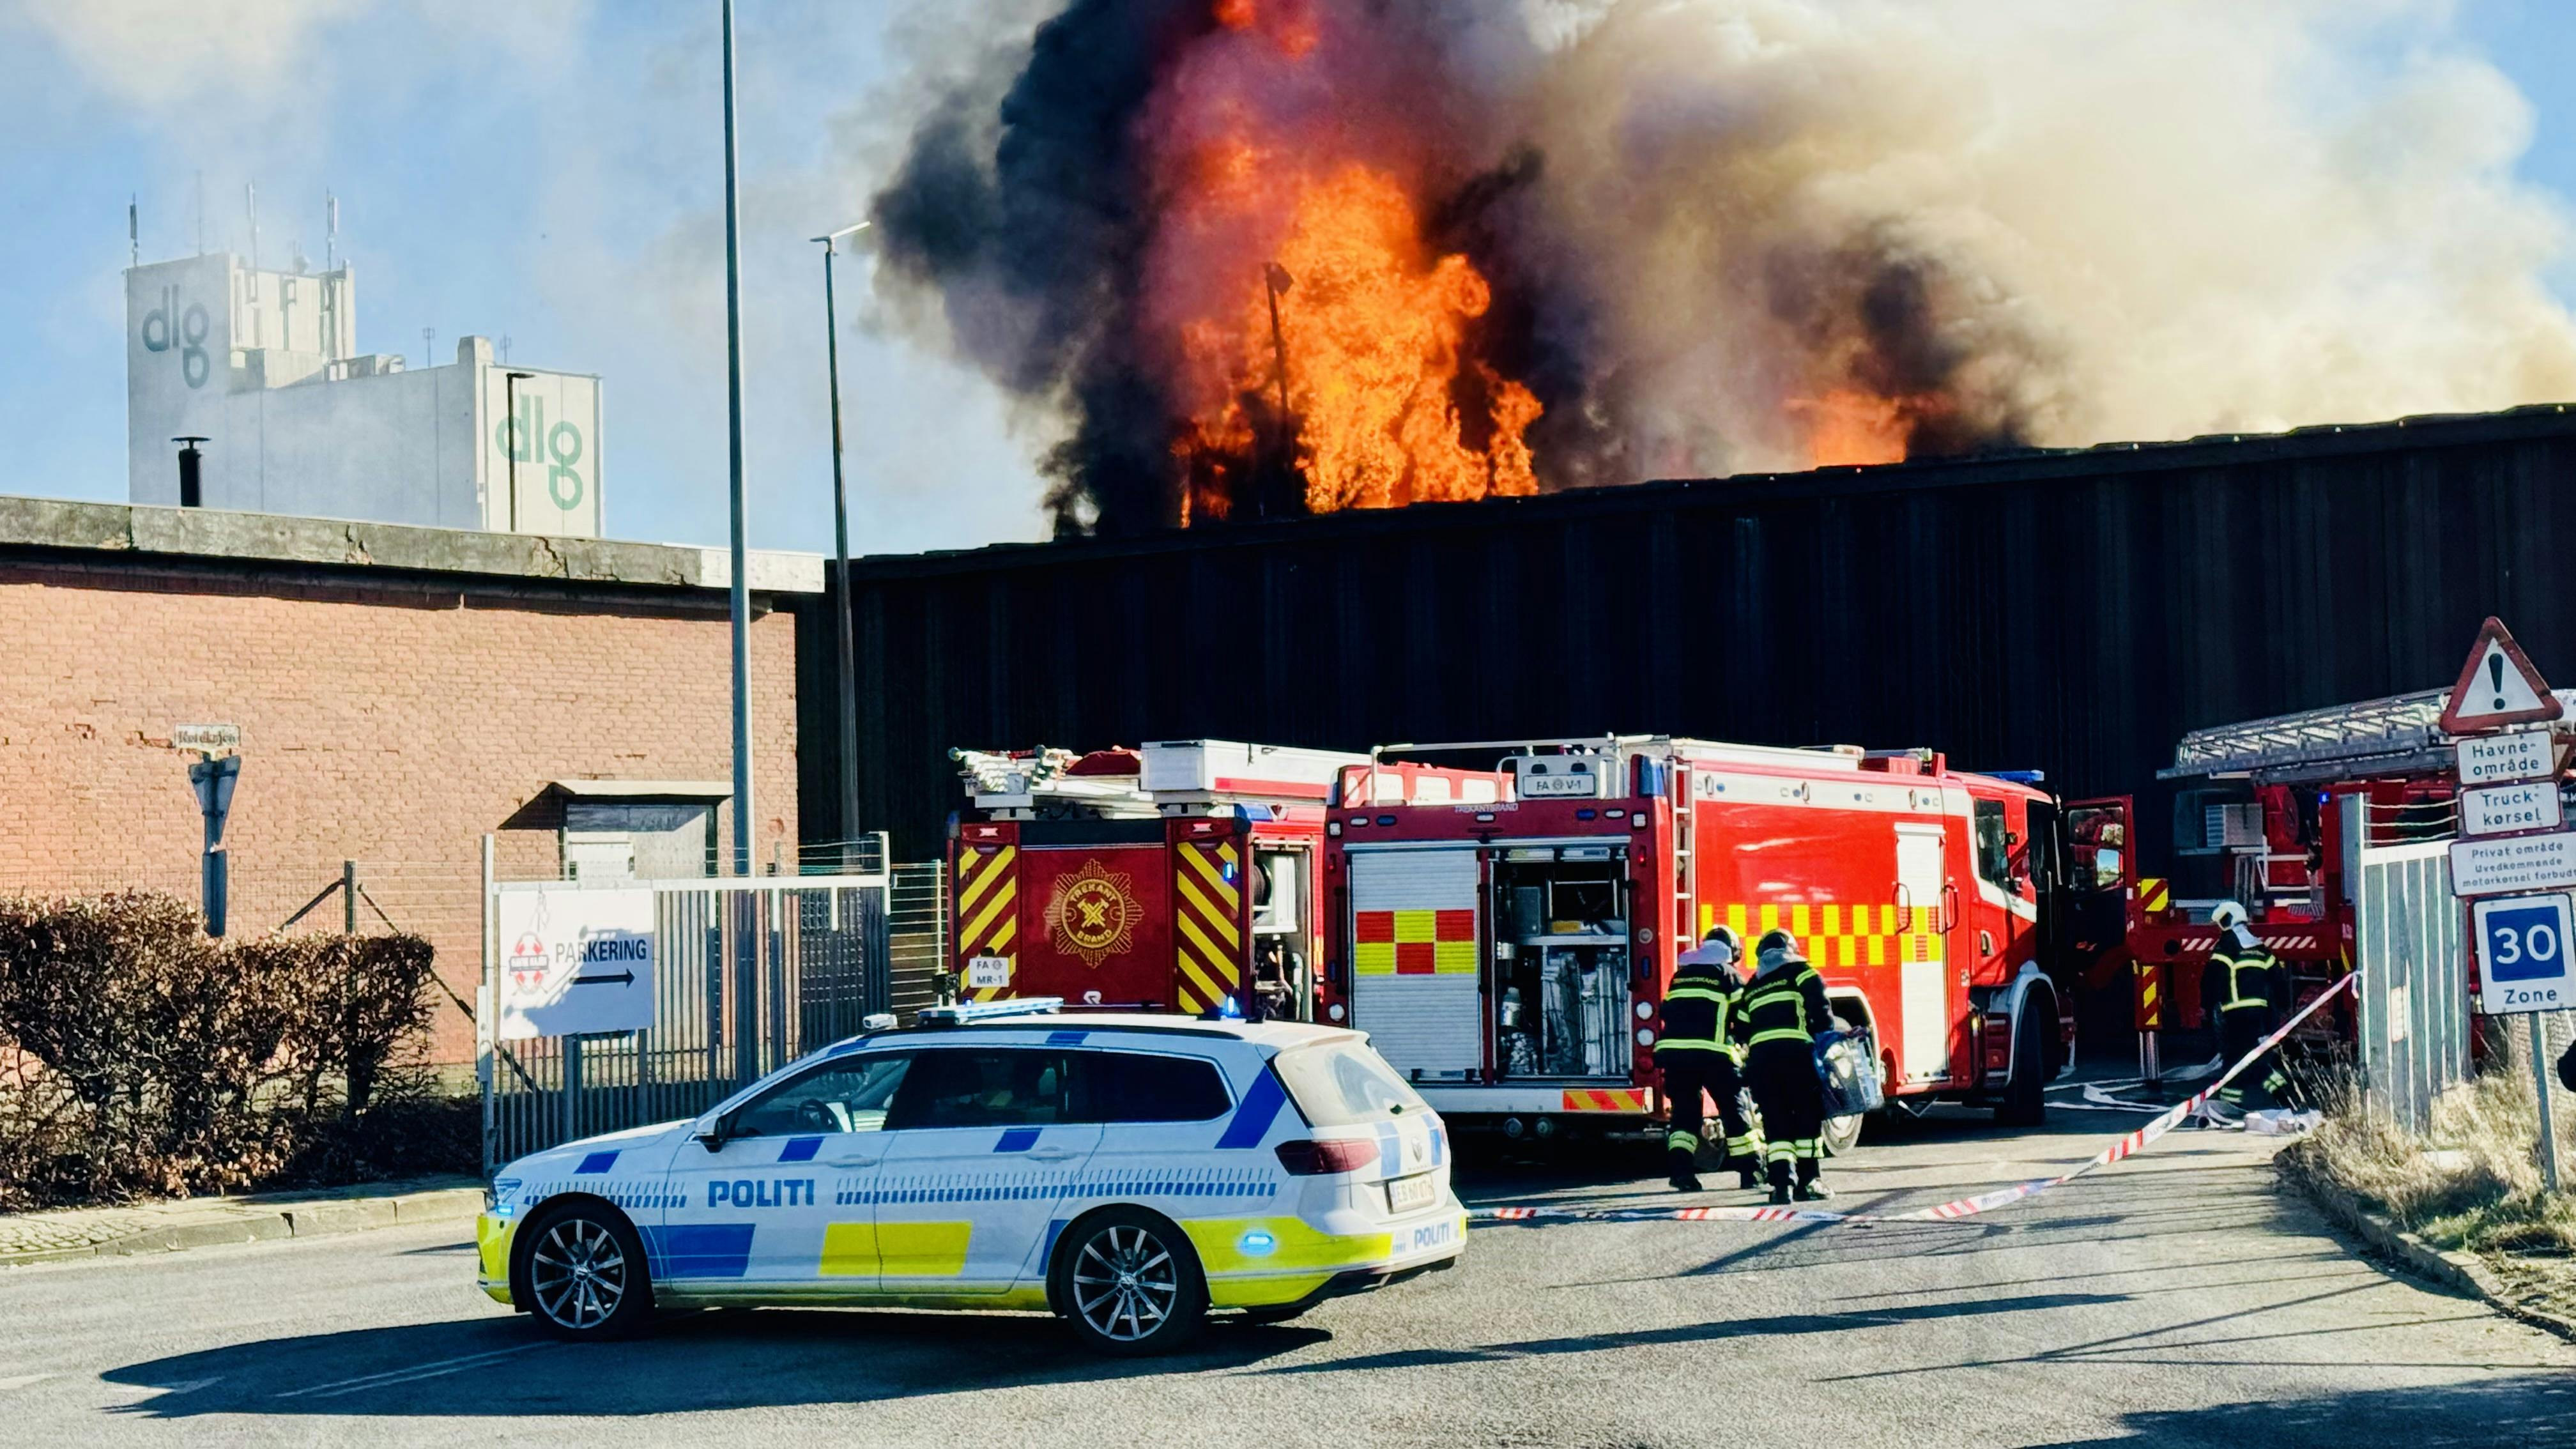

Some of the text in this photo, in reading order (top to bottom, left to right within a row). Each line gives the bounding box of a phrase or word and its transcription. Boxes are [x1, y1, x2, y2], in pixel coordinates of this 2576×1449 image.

[142, 284, 210, 388] dlg
[496, 395, 583, 510] dlg
[2472, 742, 2536, 758] Havne-
[2473, 757, 2539, 776] område
[1537, 781, 1549, 790] FA
[2482, 790, 2540, 806] Truck-
[2483, 808, 2542, 825] kørsel
[2471, 841, 2564, 859] Privat område
[2475, 857, 2563, 873] Uvedkommende
[2462, 875, 2531, 887] motorkørsel
[1070, 884, 1117, 901] TREKANT
[1077, 929, 1112, 942] BRAND
[2494, 924, 2556, 964] 30
[555, 939, 647, 963] PARKERING
[976, 960, 989, 970] FA
[976, 974, 1002, 985] MR-1
[2504, 988, 2557, 1004] Zone
[709, 1179, 815, 1208] POLITI
[1414, 1221, 1450, 1250] POLITI
